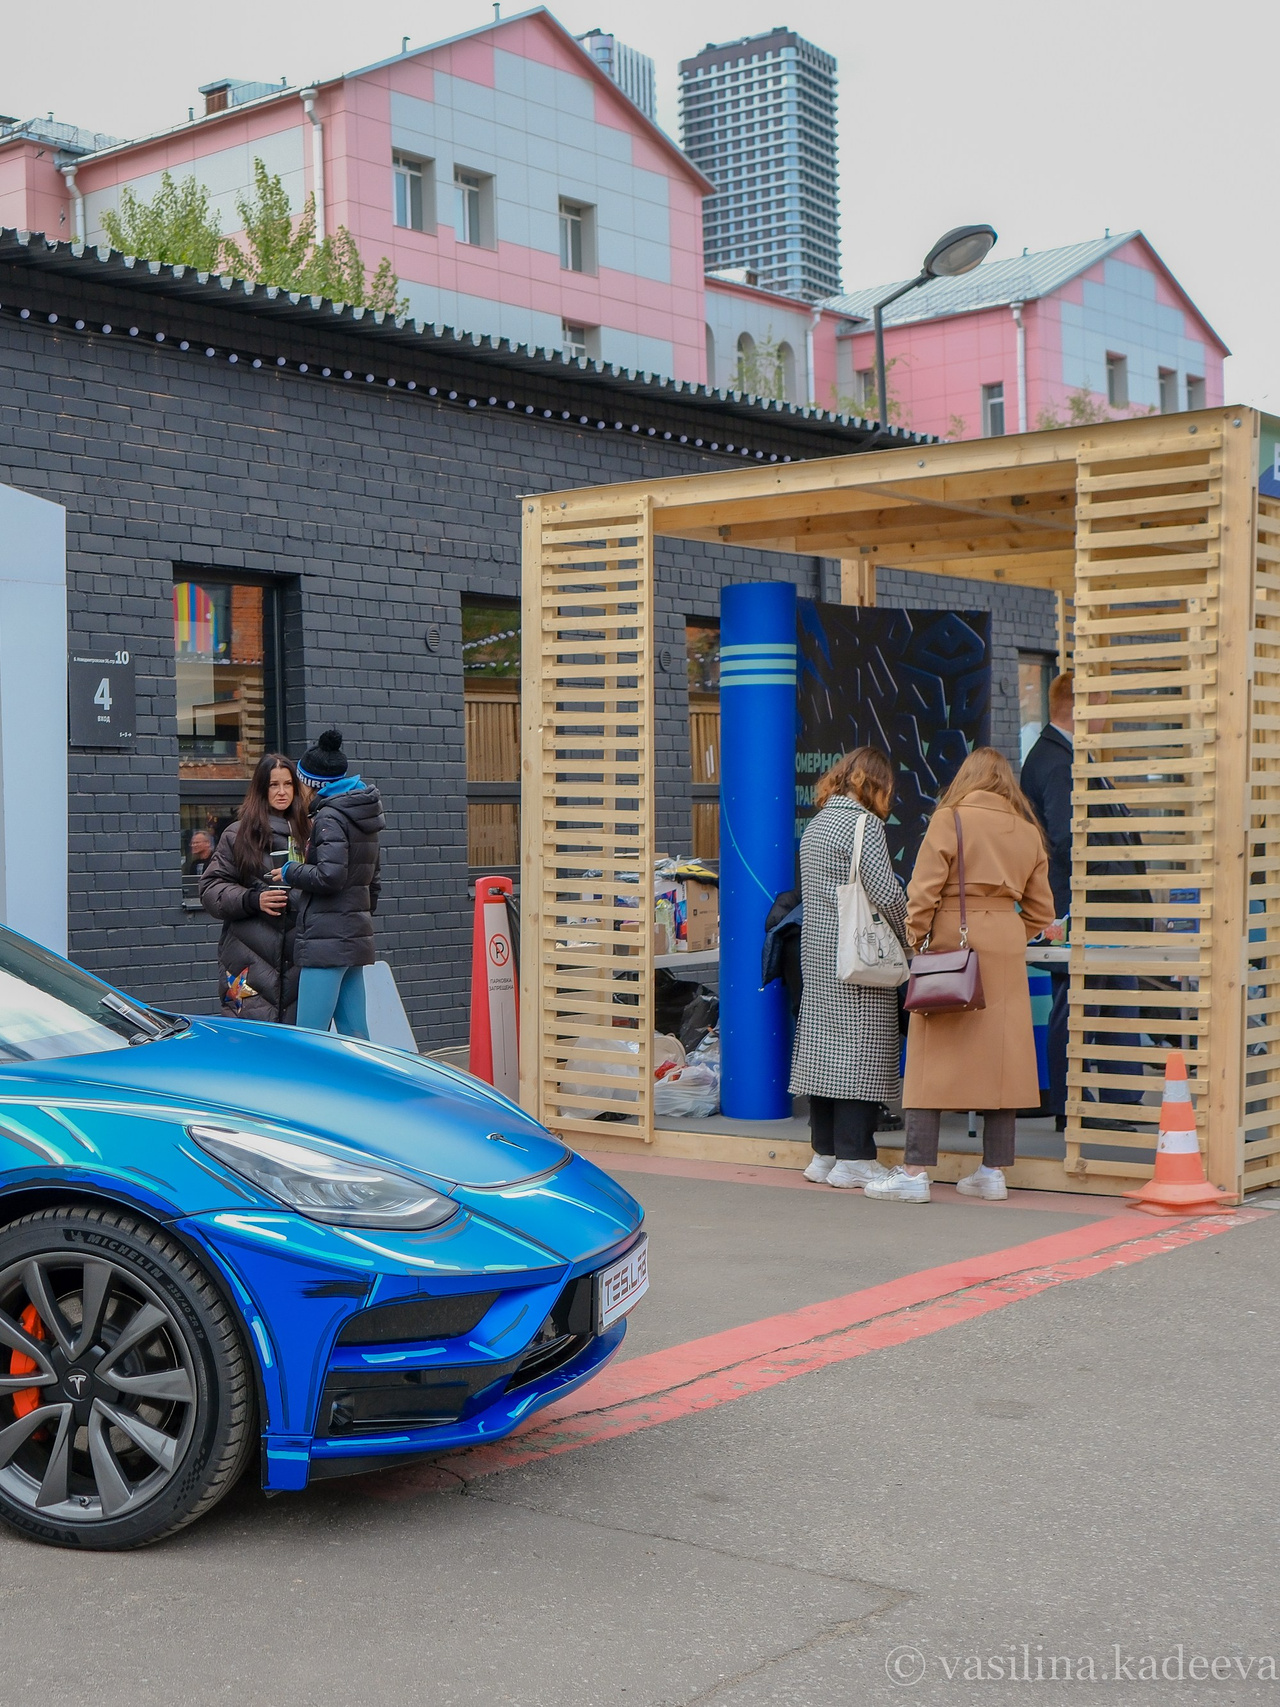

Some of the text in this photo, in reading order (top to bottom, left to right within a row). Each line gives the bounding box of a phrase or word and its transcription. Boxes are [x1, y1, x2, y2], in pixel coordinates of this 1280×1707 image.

[115, 650, 130, 665] 10
[93, 677, 113, 711] 4
[488, 984, 514, 992] ЗАПРЕЩЕНА
[87, 1233, 164, 1279] MICHELIN
